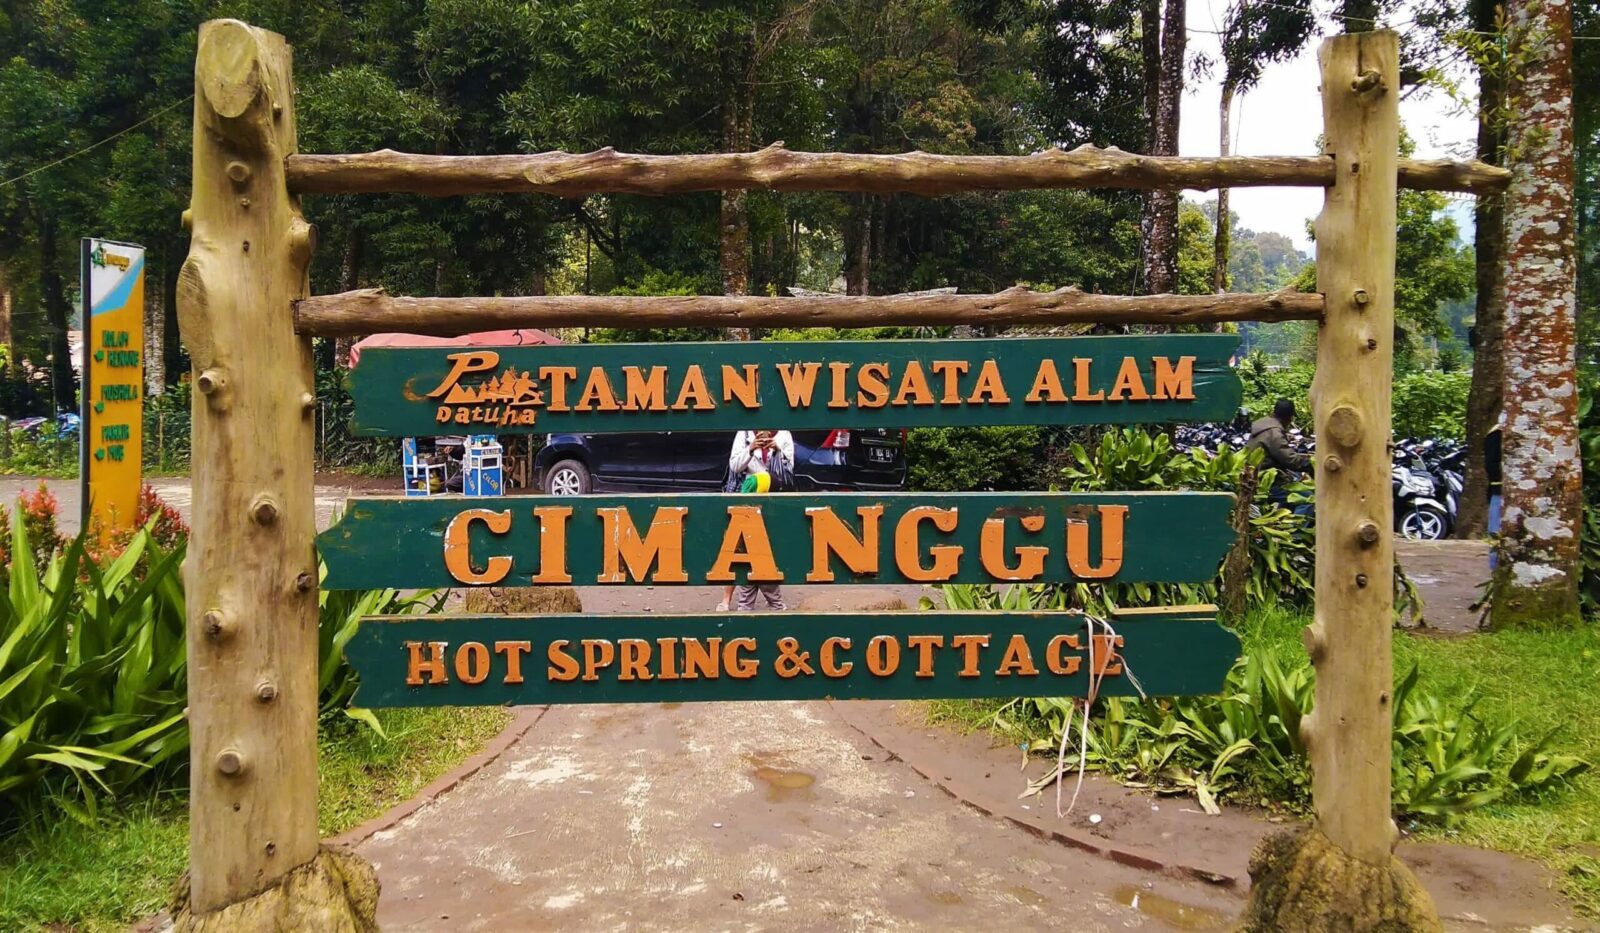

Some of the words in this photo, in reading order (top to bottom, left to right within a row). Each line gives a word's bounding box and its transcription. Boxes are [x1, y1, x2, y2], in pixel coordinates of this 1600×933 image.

[539, 364, 760, 412] TAMAN
[776, 359, 1011, 408] WISATA
[1025, 355, 1197, 402] ALAM
[443, 504, 1129, 586] CIMANGGU
[405, 640, 532, 686] HOT
[546, 637, 760, 681] SPRING
